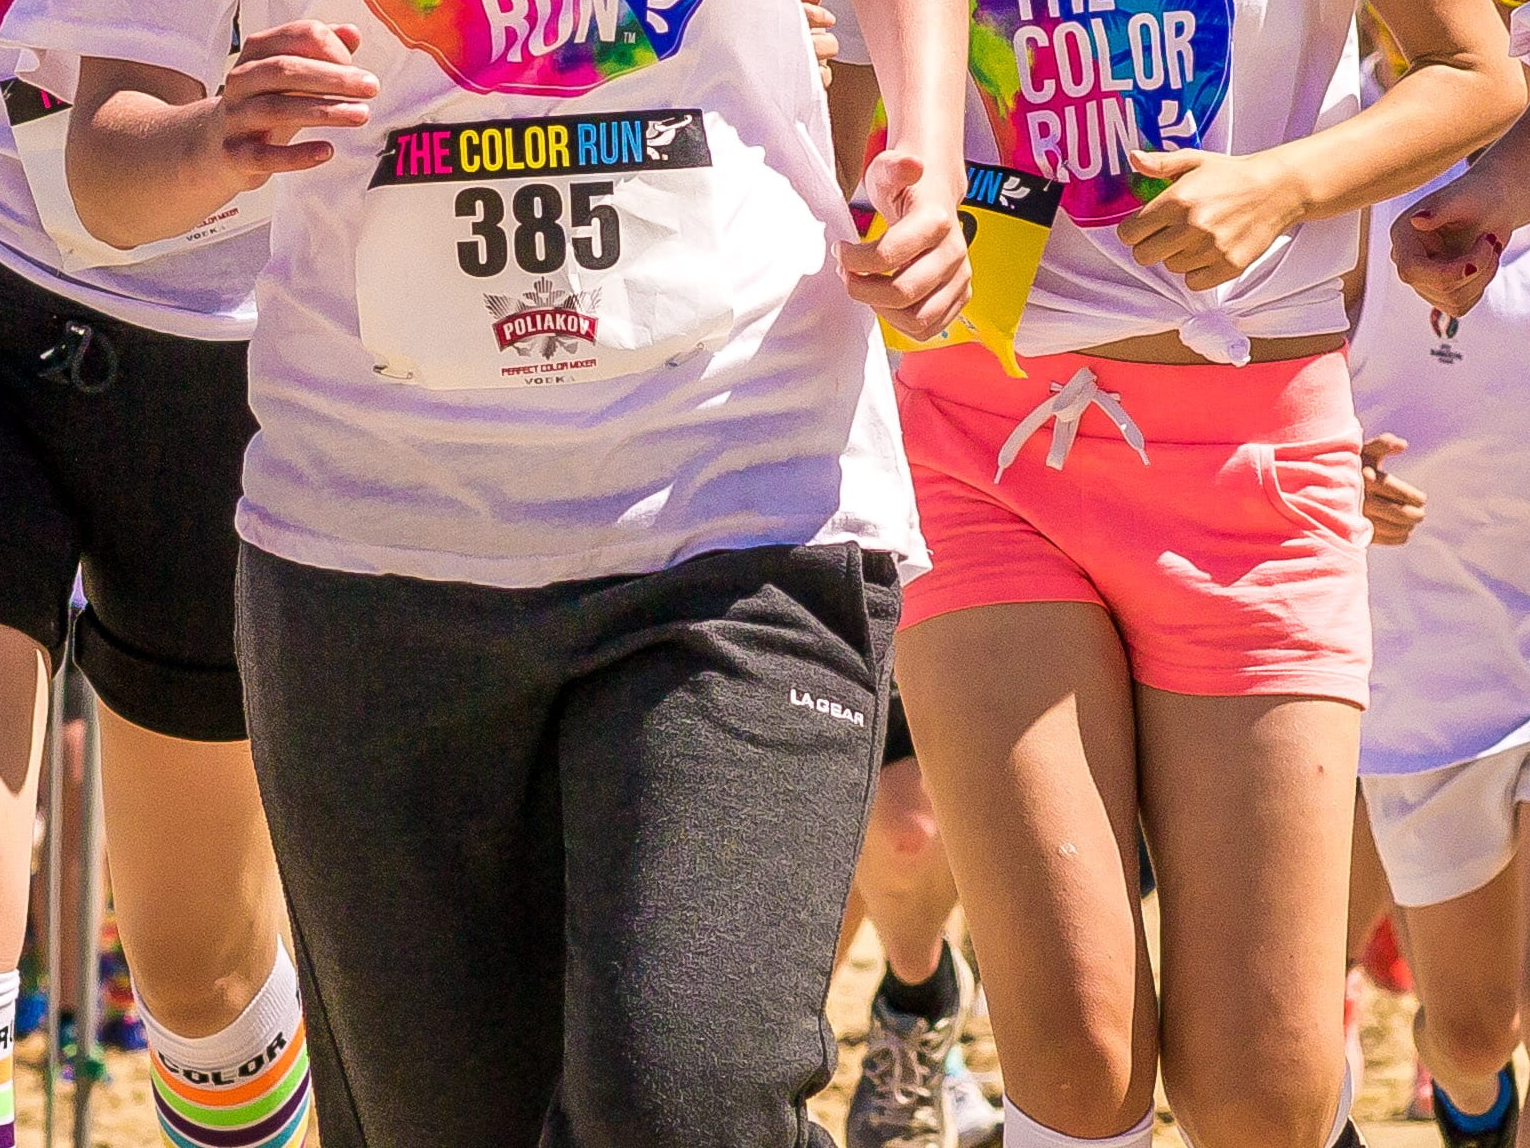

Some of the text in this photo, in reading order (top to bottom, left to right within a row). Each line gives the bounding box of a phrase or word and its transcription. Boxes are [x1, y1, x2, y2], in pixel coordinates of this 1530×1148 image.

[1013, 10, 1196, 105] COLOR
[396, 120, 642, 176] THE COLOR RUN
[1026, 97, 1142, 183] RUN
[967, 167, 1003, 204] UN
[454, 180, 620, 278] 385
[502, 313, 589, 340] POLIAKOV
[501, 358, 597, 377] PERFECT COLOR MIXER
[790, 688, 864, 728] LA GEAR
[158, 1031, 287, 1086] COLOR
